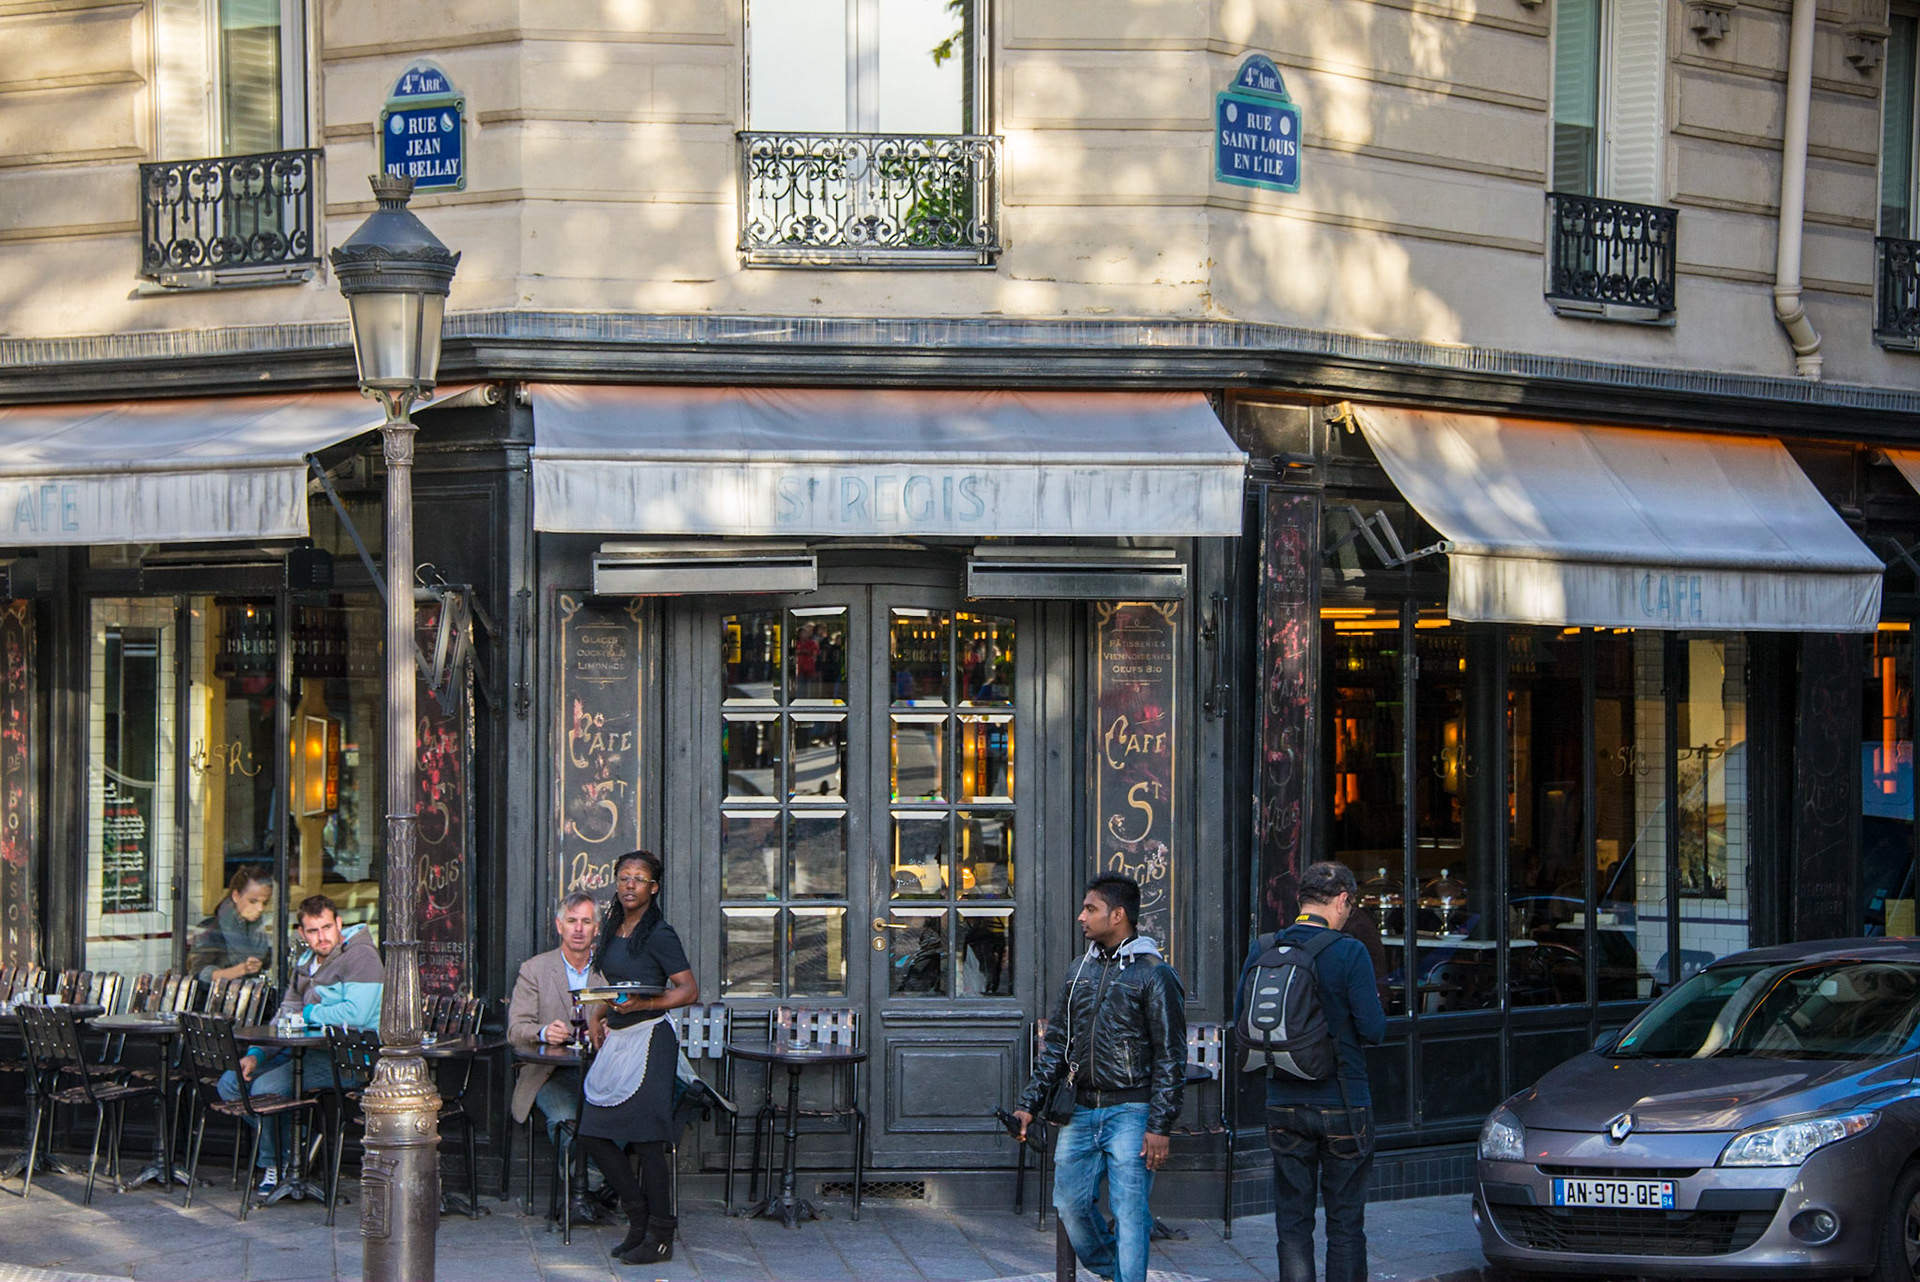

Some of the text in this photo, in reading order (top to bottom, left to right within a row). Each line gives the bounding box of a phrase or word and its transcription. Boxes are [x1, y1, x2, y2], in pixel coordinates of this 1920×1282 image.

[408, 116, 437, 135] RUE
[1247, 113, 1272, 131] RUE
[406, 138, 441, 157] JEAN
[1222, 130, 1295, 156] SAINT LOUIS
[388, 158, 459, 179] DU BELLAY
[1234, 153, 1250, 170] EN
[841, 475, 985, 522] REGIS
[1640, 574, 1702, 618] CAFE
[1112, 665, 1143, 673] OEUFS
[1663, 1196, 1672, 1206] 94
